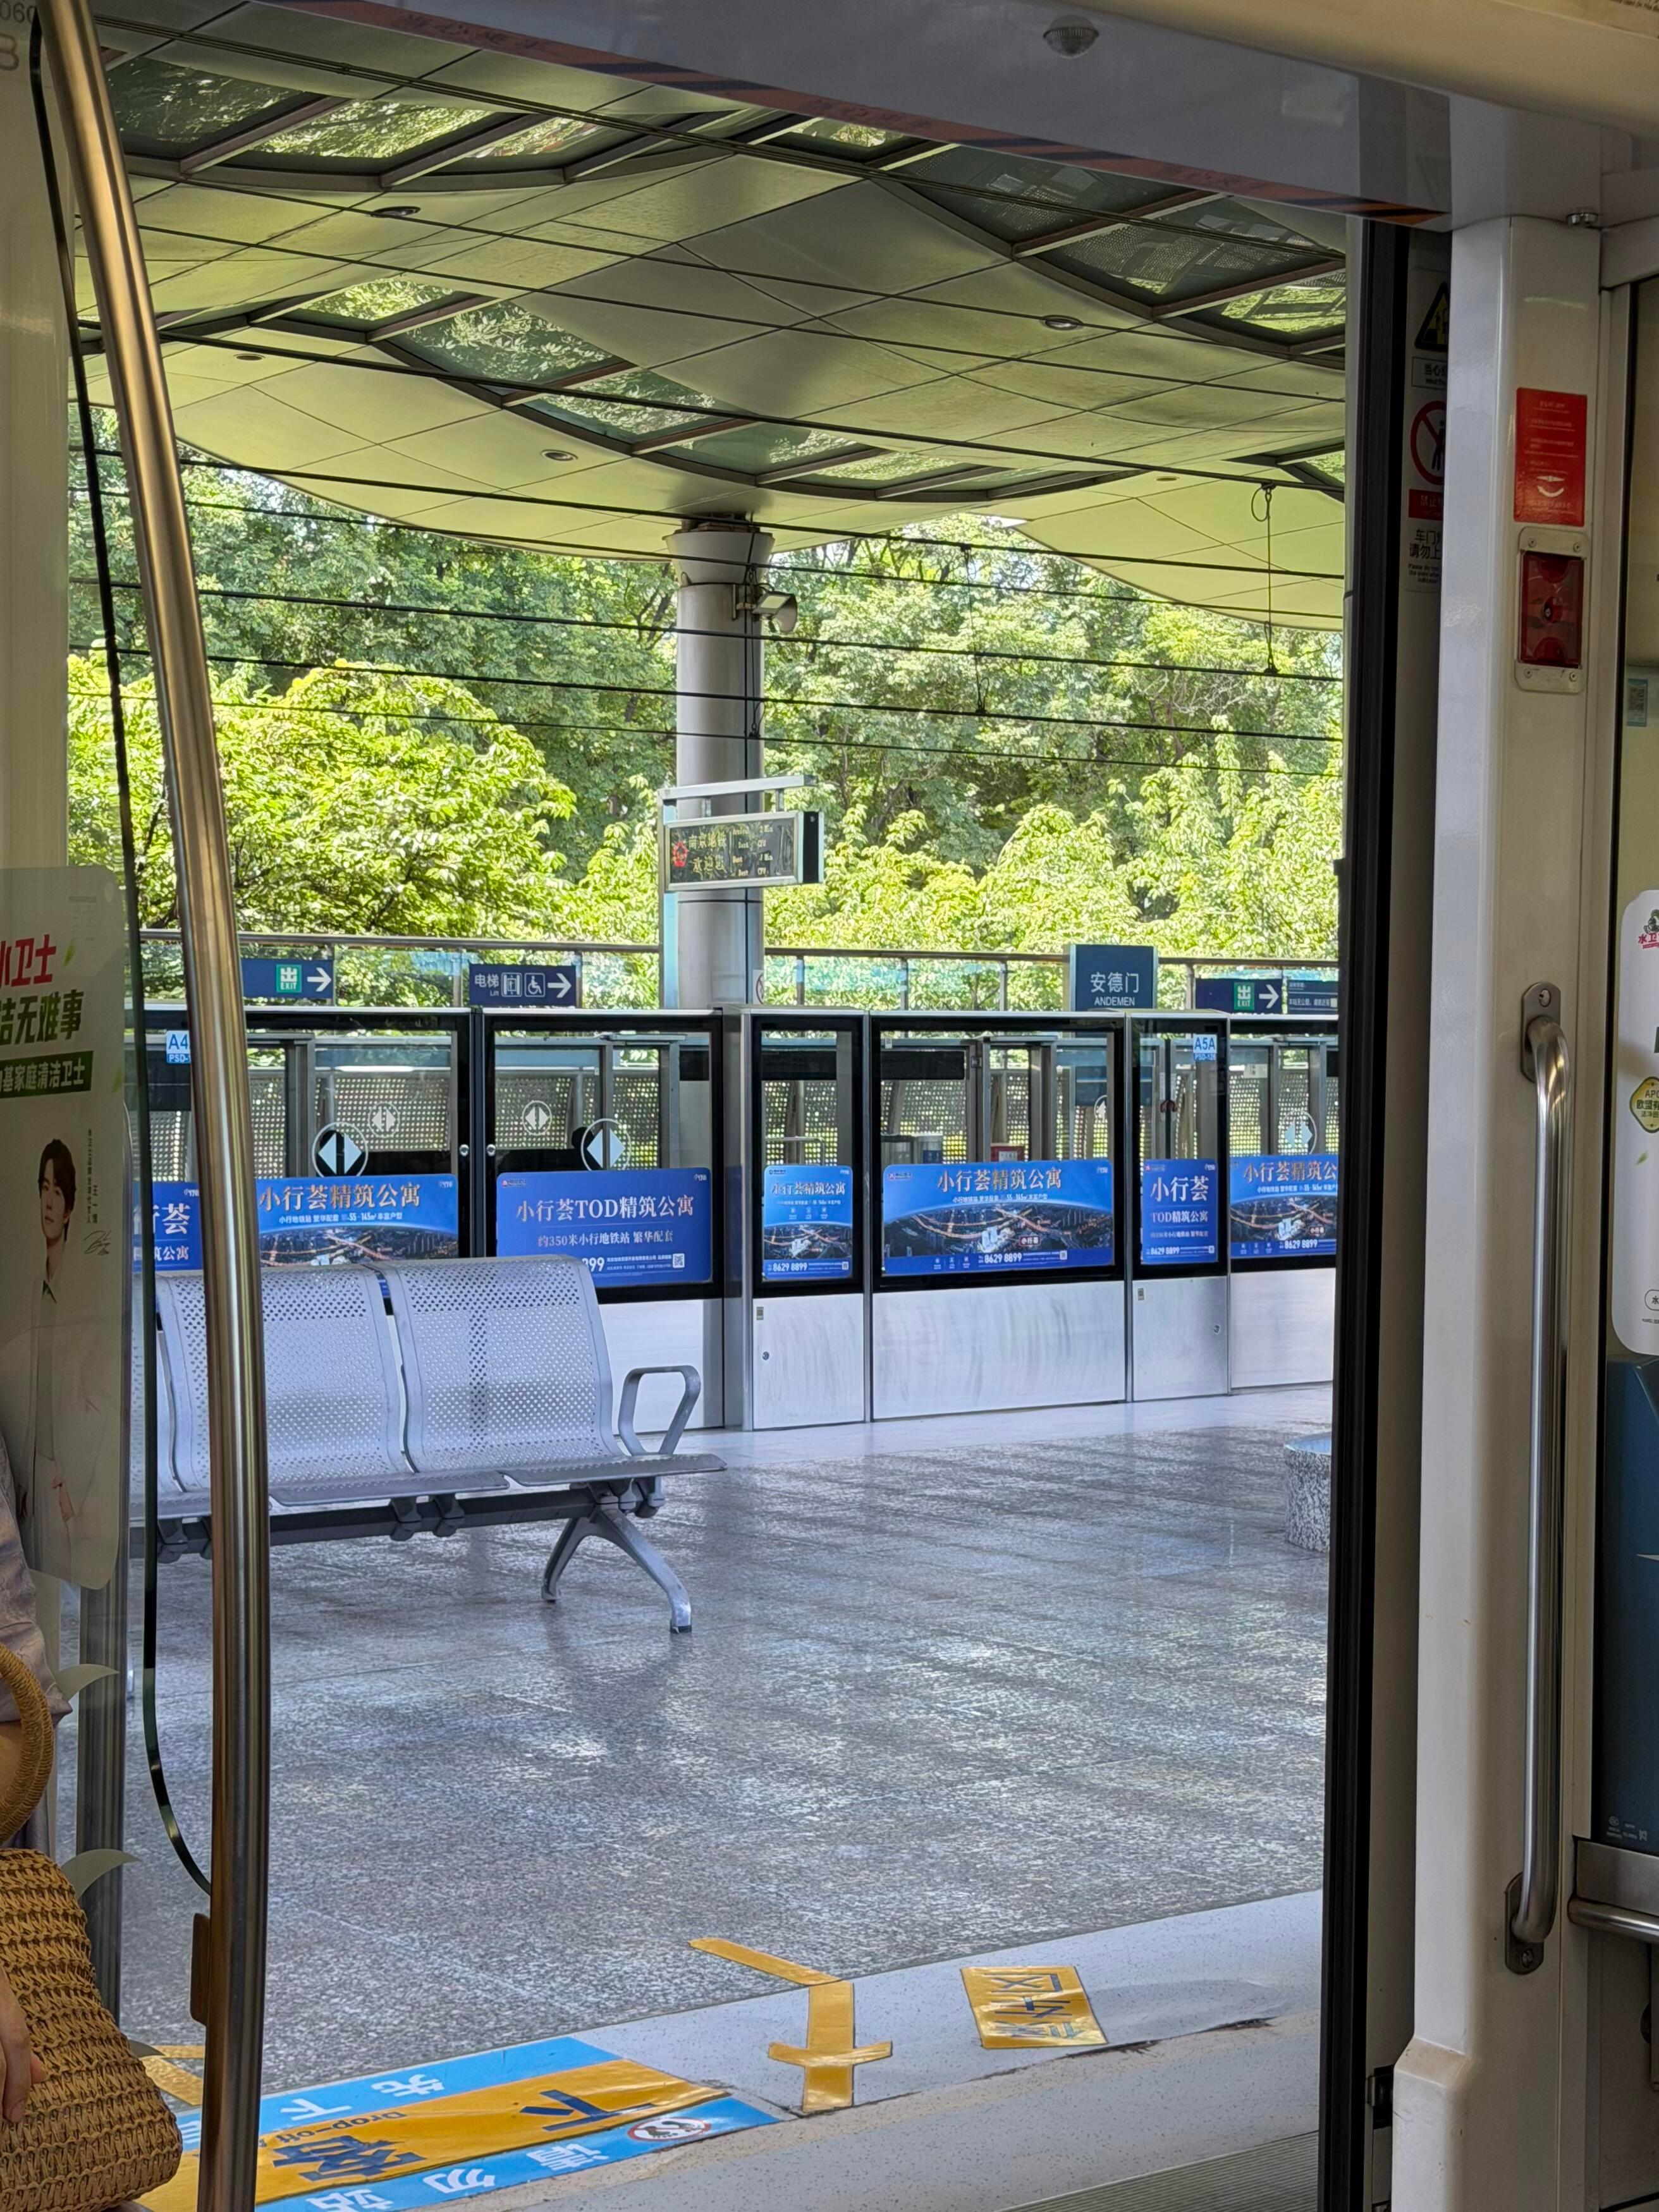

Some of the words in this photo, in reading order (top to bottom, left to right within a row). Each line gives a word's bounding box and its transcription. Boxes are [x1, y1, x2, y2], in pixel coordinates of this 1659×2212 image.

[475, 974, 499, 987] 电梯
[1090, 972, 1139, 993] 安德门
[1094, 996, 1136, 1006] ANDEMEN
[168, 1034, 188, 1049] A4
[1194, 1037, 1215, 1050] A5A
[168, 1054, 190, 1062] PSD-
[0, 1058, 85, 1092] 基家庭清洁卫士
[938, 1167, 1062, 1192] 小行荟精筑公寓
[1244, 1160, 1337, 1183] 小行荟精筑公
[772, 1181, 846, 1195] 小行荟精筑公寓
[1151, 1175, 1209, 1202] 小行荟
[259, 1182, 420, 1211] 小行荟精筑公寓
[516, 1194, 694, 1223] 小行荟TOD精筑公寓
[1151, 1210, 1208, 1223] TOD精筑公寓
[537, 1231, 630, 1248] 约350米小行地铁站
[633, 1230, 674, 1243] 繁华配套
[984, 1254, 1003, 1264] 8629
[1003, 1252, 1022, 1263] 8899
[773, 1263, 790, 1272] 8629
[791, 1262, 807, 1271] 8899
[269, 2111, 408, 2143] Drop-off
